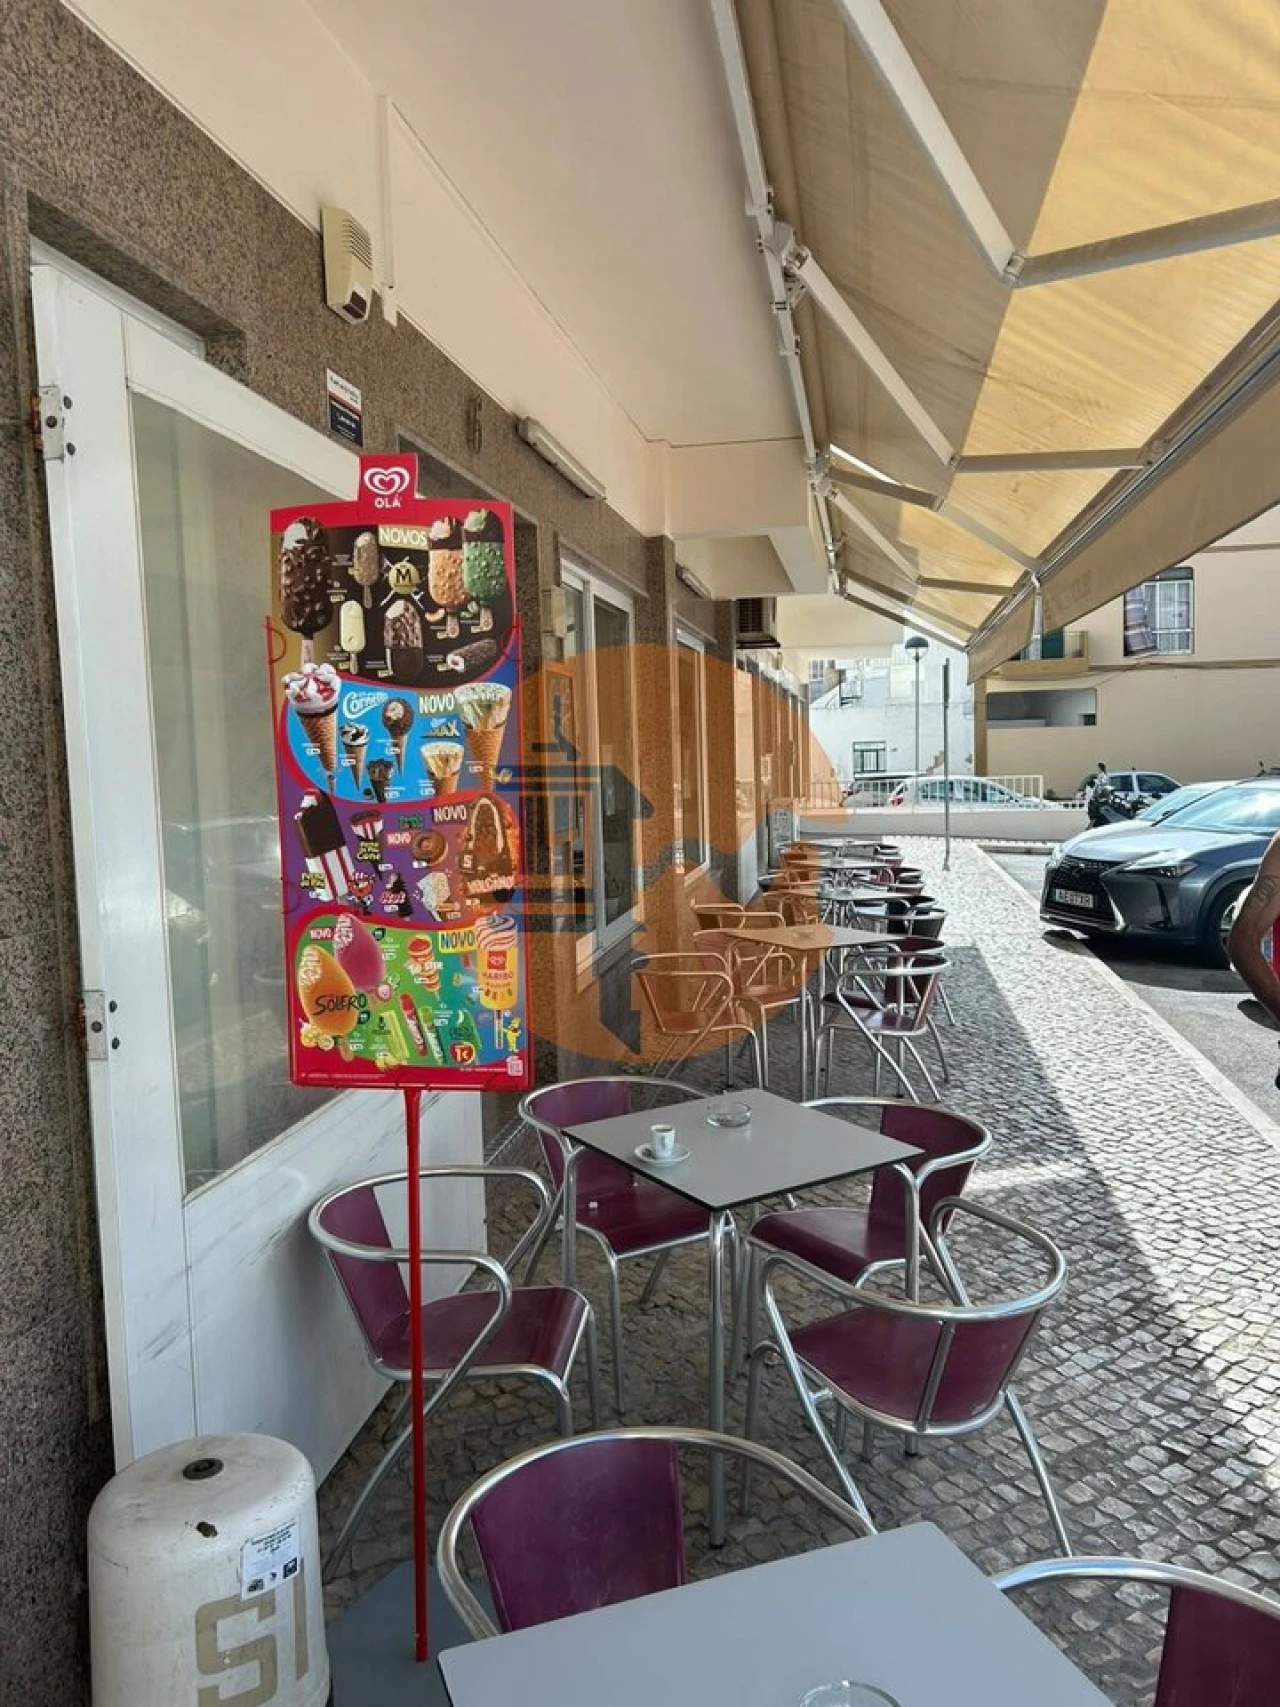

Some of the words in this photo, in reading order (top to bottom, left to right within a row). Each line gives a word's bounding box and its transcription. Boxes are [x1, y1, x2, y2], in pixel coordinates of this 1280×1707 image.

[379, 527, 428, 547] NOVOS
[419, 693, 455, 714] NOVO
[433, 804, 467, 823] NOVO
[387, 831, 411, 844] NOVO
[310, 928, 332, 940] NOVO
[440, 929, 477, 949] NOVO
[312, 993, 367, 1016] SOLERO
